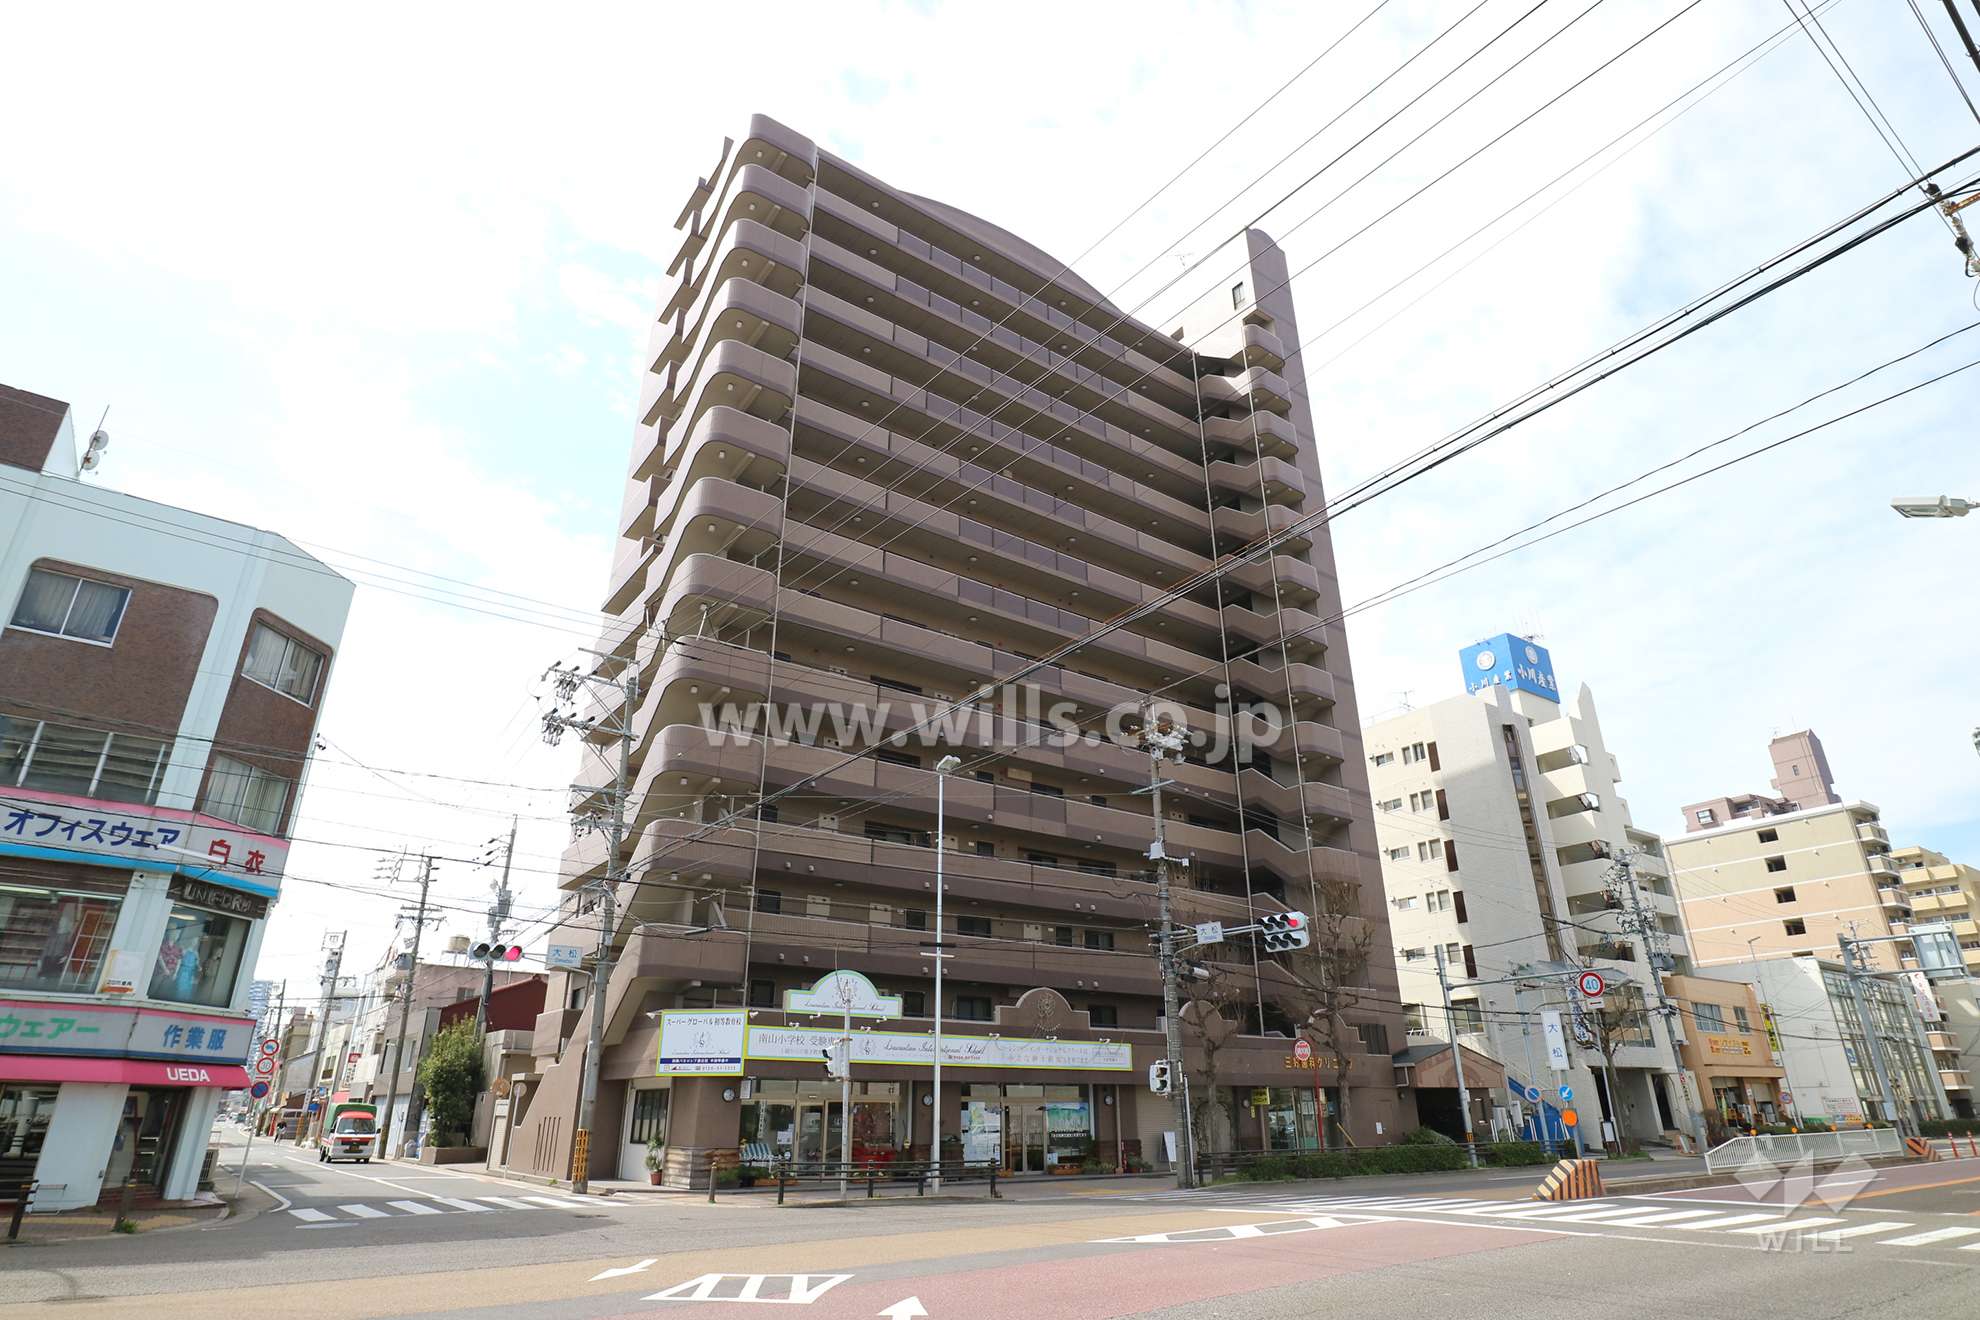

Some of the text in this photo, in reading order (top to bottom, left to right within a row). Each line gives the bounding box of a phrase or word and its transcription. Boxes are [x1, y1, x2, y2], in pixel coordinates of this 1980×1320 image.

[4, 809, 181, 848] オフィスウェア
[208, 839, 266, 873] 白衣
[1585, 978, 1599, 990] 40
[162, 1024, 228, 1051] 作業服
[1547, 1022, 1564, 1059] 大松
[166, 1066, 210, 1083] UEDA
